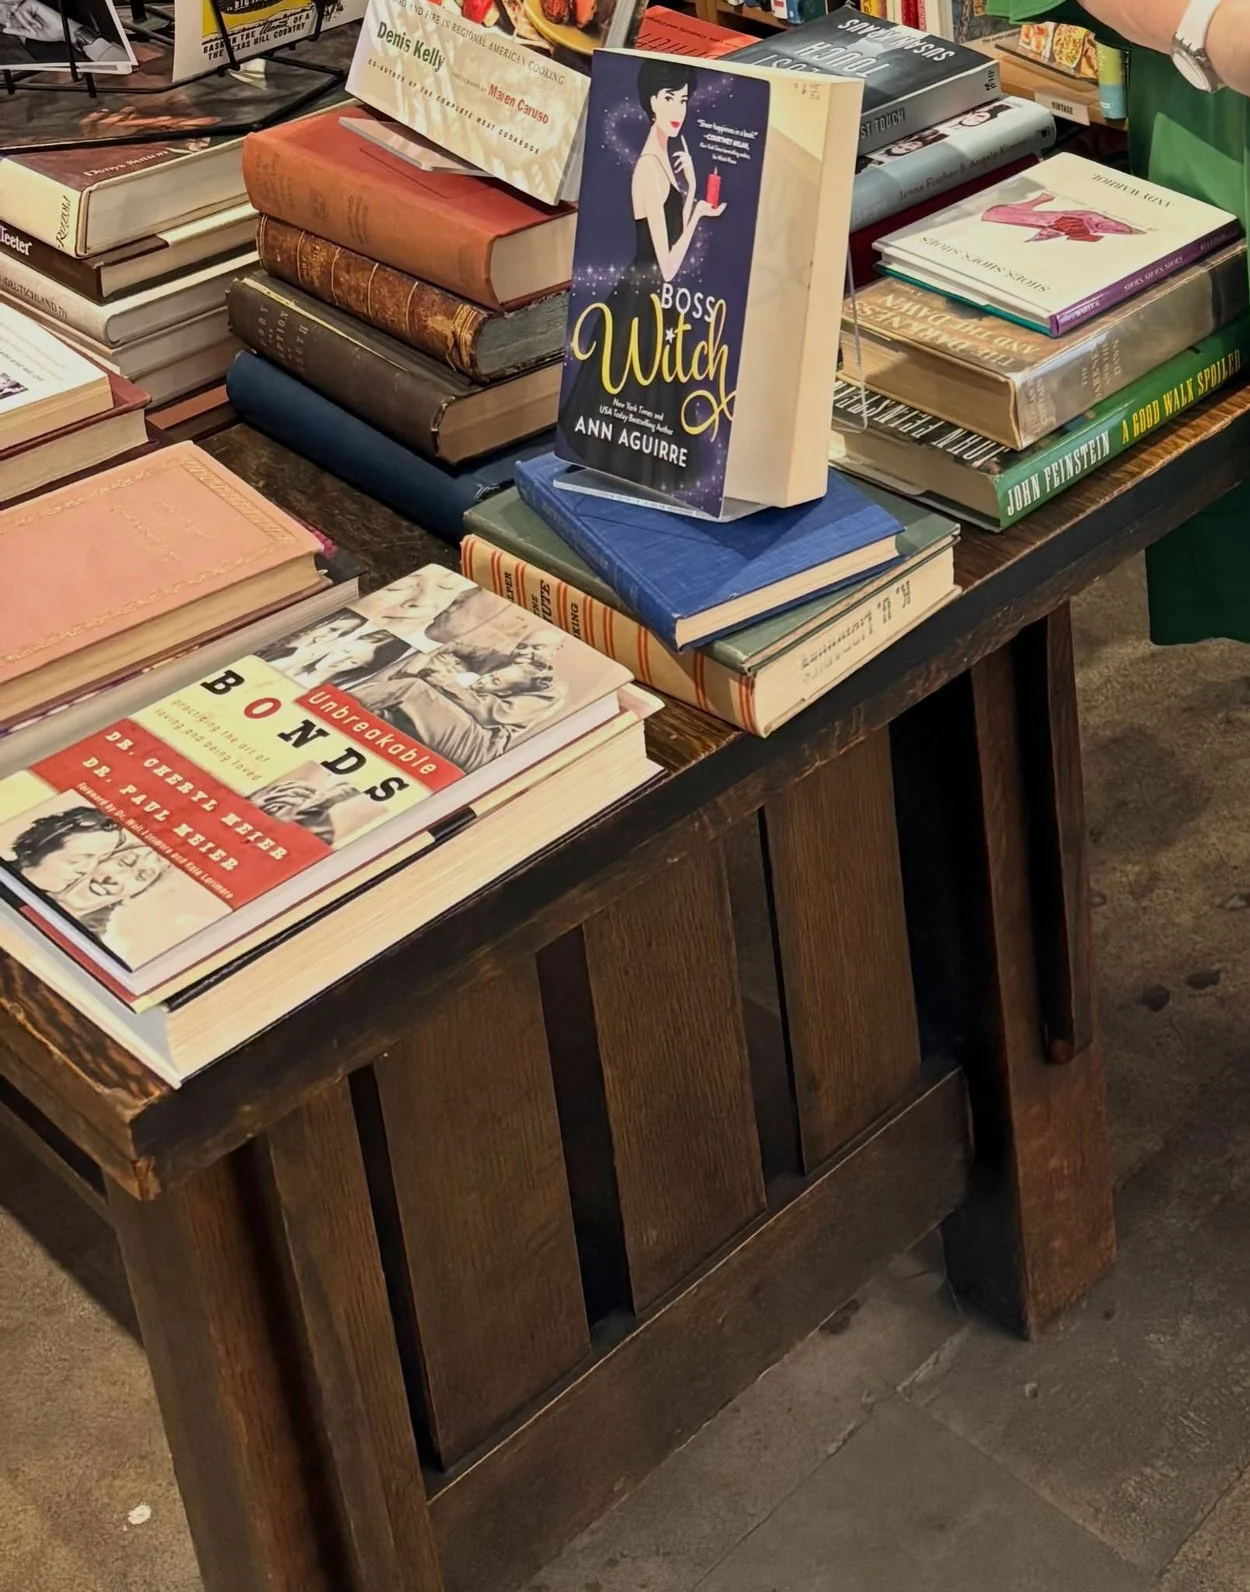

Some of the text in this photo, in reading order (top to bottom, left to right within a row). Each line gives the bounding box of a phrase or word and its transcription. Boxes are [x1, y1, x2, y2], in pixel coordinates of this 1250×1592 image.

[253, 22, 306, 48] HILL COUNTRY
[377, 21, 446, 73] Denis Kelly
[409, 1, 424, 16] AND
[424, 9, 440, 25] FIRE
[441, 17, 451, 29] IN
[451, 20, 487, 48] REGIONAL
[489, 41, 526, 66] AMERICAN
[528, 61, 566, 86] COOKING
[838, 19, 897, 45] KRAUS
[894, 36, 956, 61] SUSAN
[794, 41, 891, 77] TOUCH
[487, 84, 550, 125] Maren Caruso
[875, 109, 906, 134] TOUCH
[1051, 101, 1073, 116] VINTAGE
[660, 283, 716, 322] BOSS
[571, 293, 738, 442] Witch
[574, 415, 689, 469] ANN AGUIRRE
[599, 404, 675, 436] USA Today Bestselling Author
[1006, 348, 1242, 518] JOHN FEINSTEIN A GOOD WALK SPOILED
[200, 669, 410, 802] BONDS
[308, 690, 438, 776] Unbreakable
[82, 756, 240, 872] DR. PAUL MEIER
[105, 730, 289, 861] DR. CHERYL MEIER
